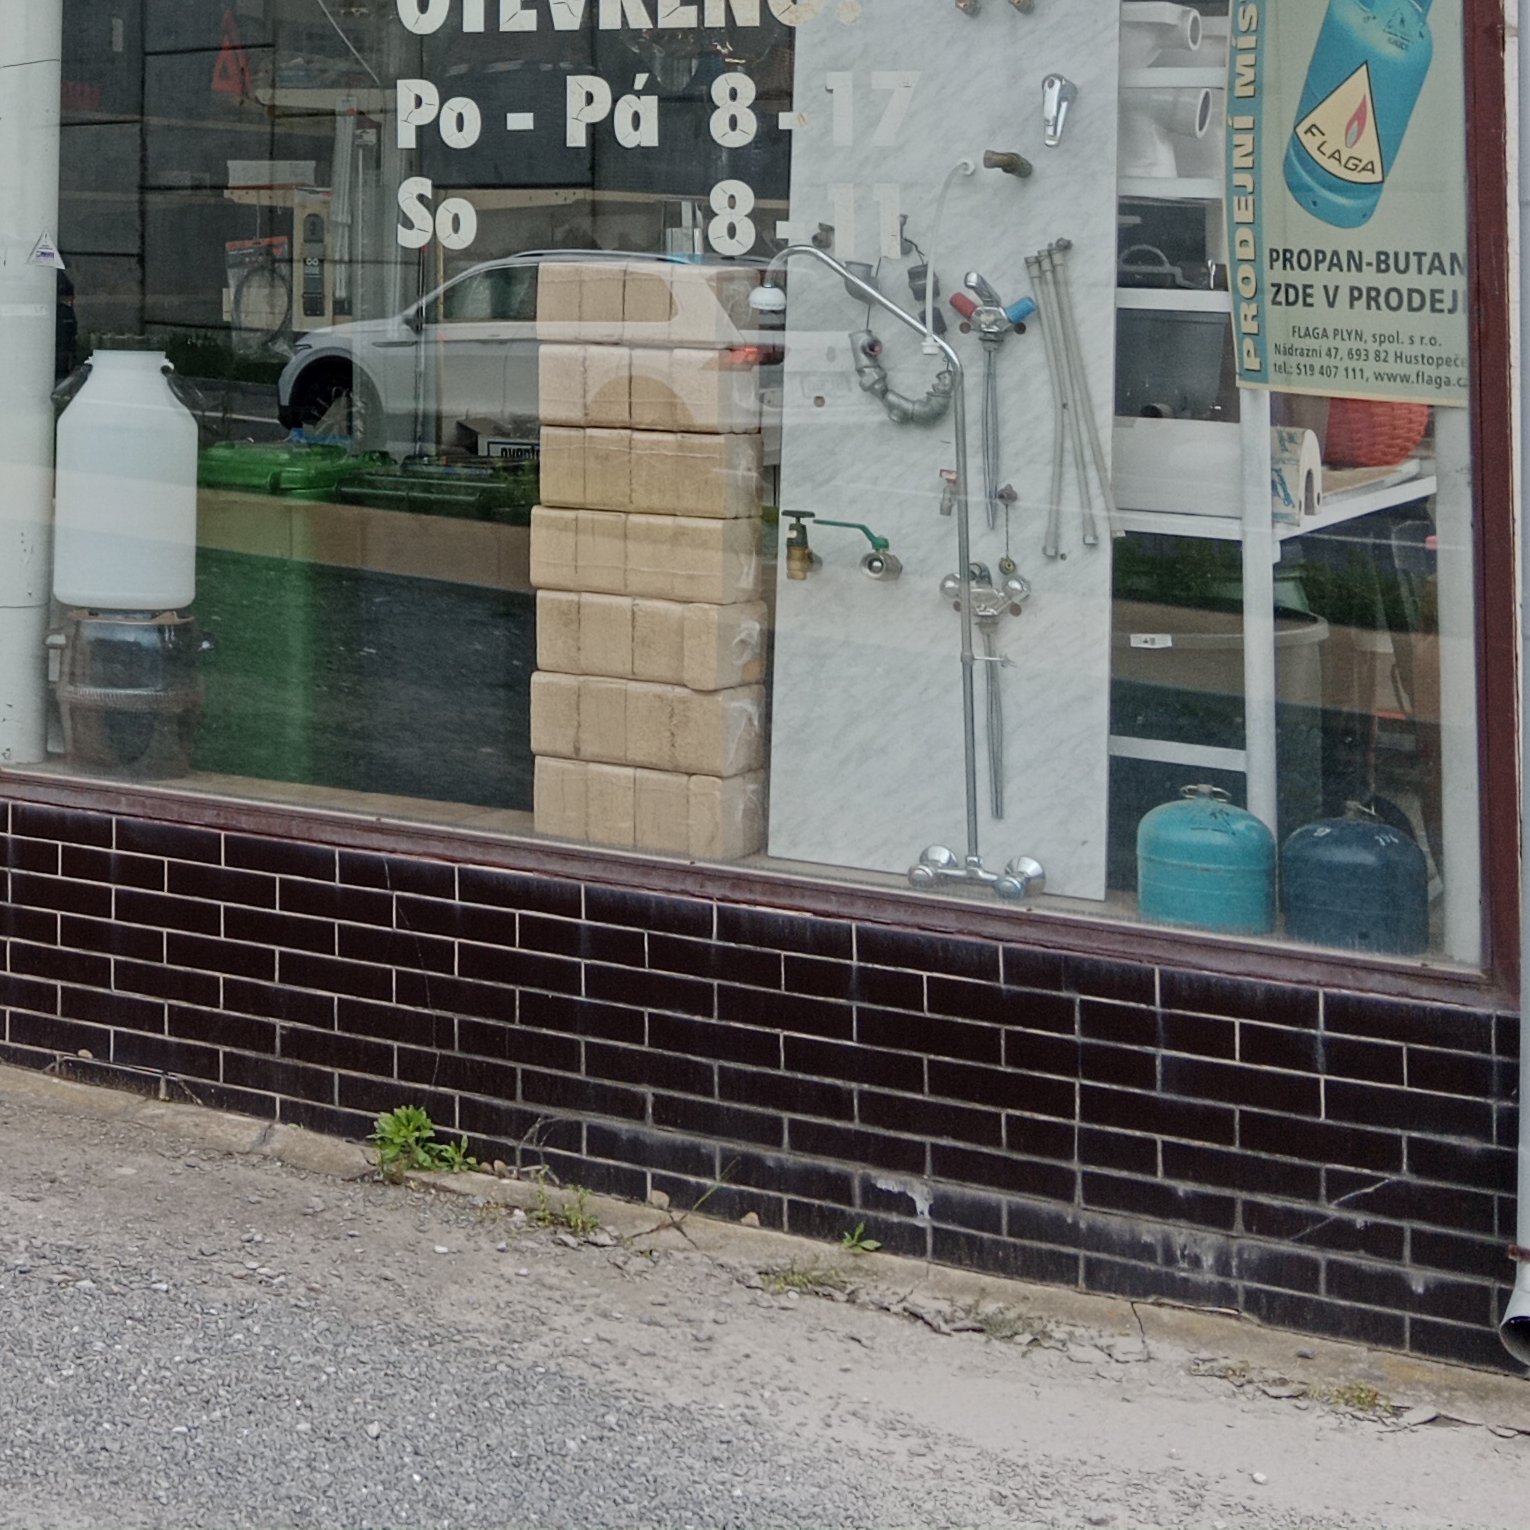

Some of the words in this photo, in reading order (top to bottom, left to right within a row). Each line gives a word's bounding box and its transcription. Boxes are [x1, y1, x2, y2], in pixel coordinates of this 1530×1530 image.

[396, 79, 481, 148] Po
[506, 112, 534, 130] -
[567, 73, 659, 148] Pá
[710, 72, 758, 148] 8
[826, 71, 920, 147] 17
[1304, 123, 1376, 175] FLAGA
[397, 177, 477, 250] So
[708, 179, 756, 256] 8
[827, 182, 901, 259] 11
[1228, 115, 1262, 372] PRODEJNÍ
[1269, 248, 1468, 276] PROPAN-BUTAN
[1271, 282, 1314, 308] ZDE
[1323, 284, 1340, 309] V
[1292, 325, 1329, 340] FLAGA
[1333, 327, 1368, 344] PLYN,
[1372, 330, 1404, 347] spol.
[1409, 335, 1415, 345] s
[1420, 336, 1442, 347] r.o.
[1325, 346, 1343, 362] 47,
[1347, 347, 1369, 362] 693
[1374, 350, 1389, 363] 82
[1296, 362, 1315, 376] 519
[1319, 364, 1339, 379] 407
[1344, 366, 1369, 383] 111,
[1373, 370, 1468, 389] www.flaga.c
